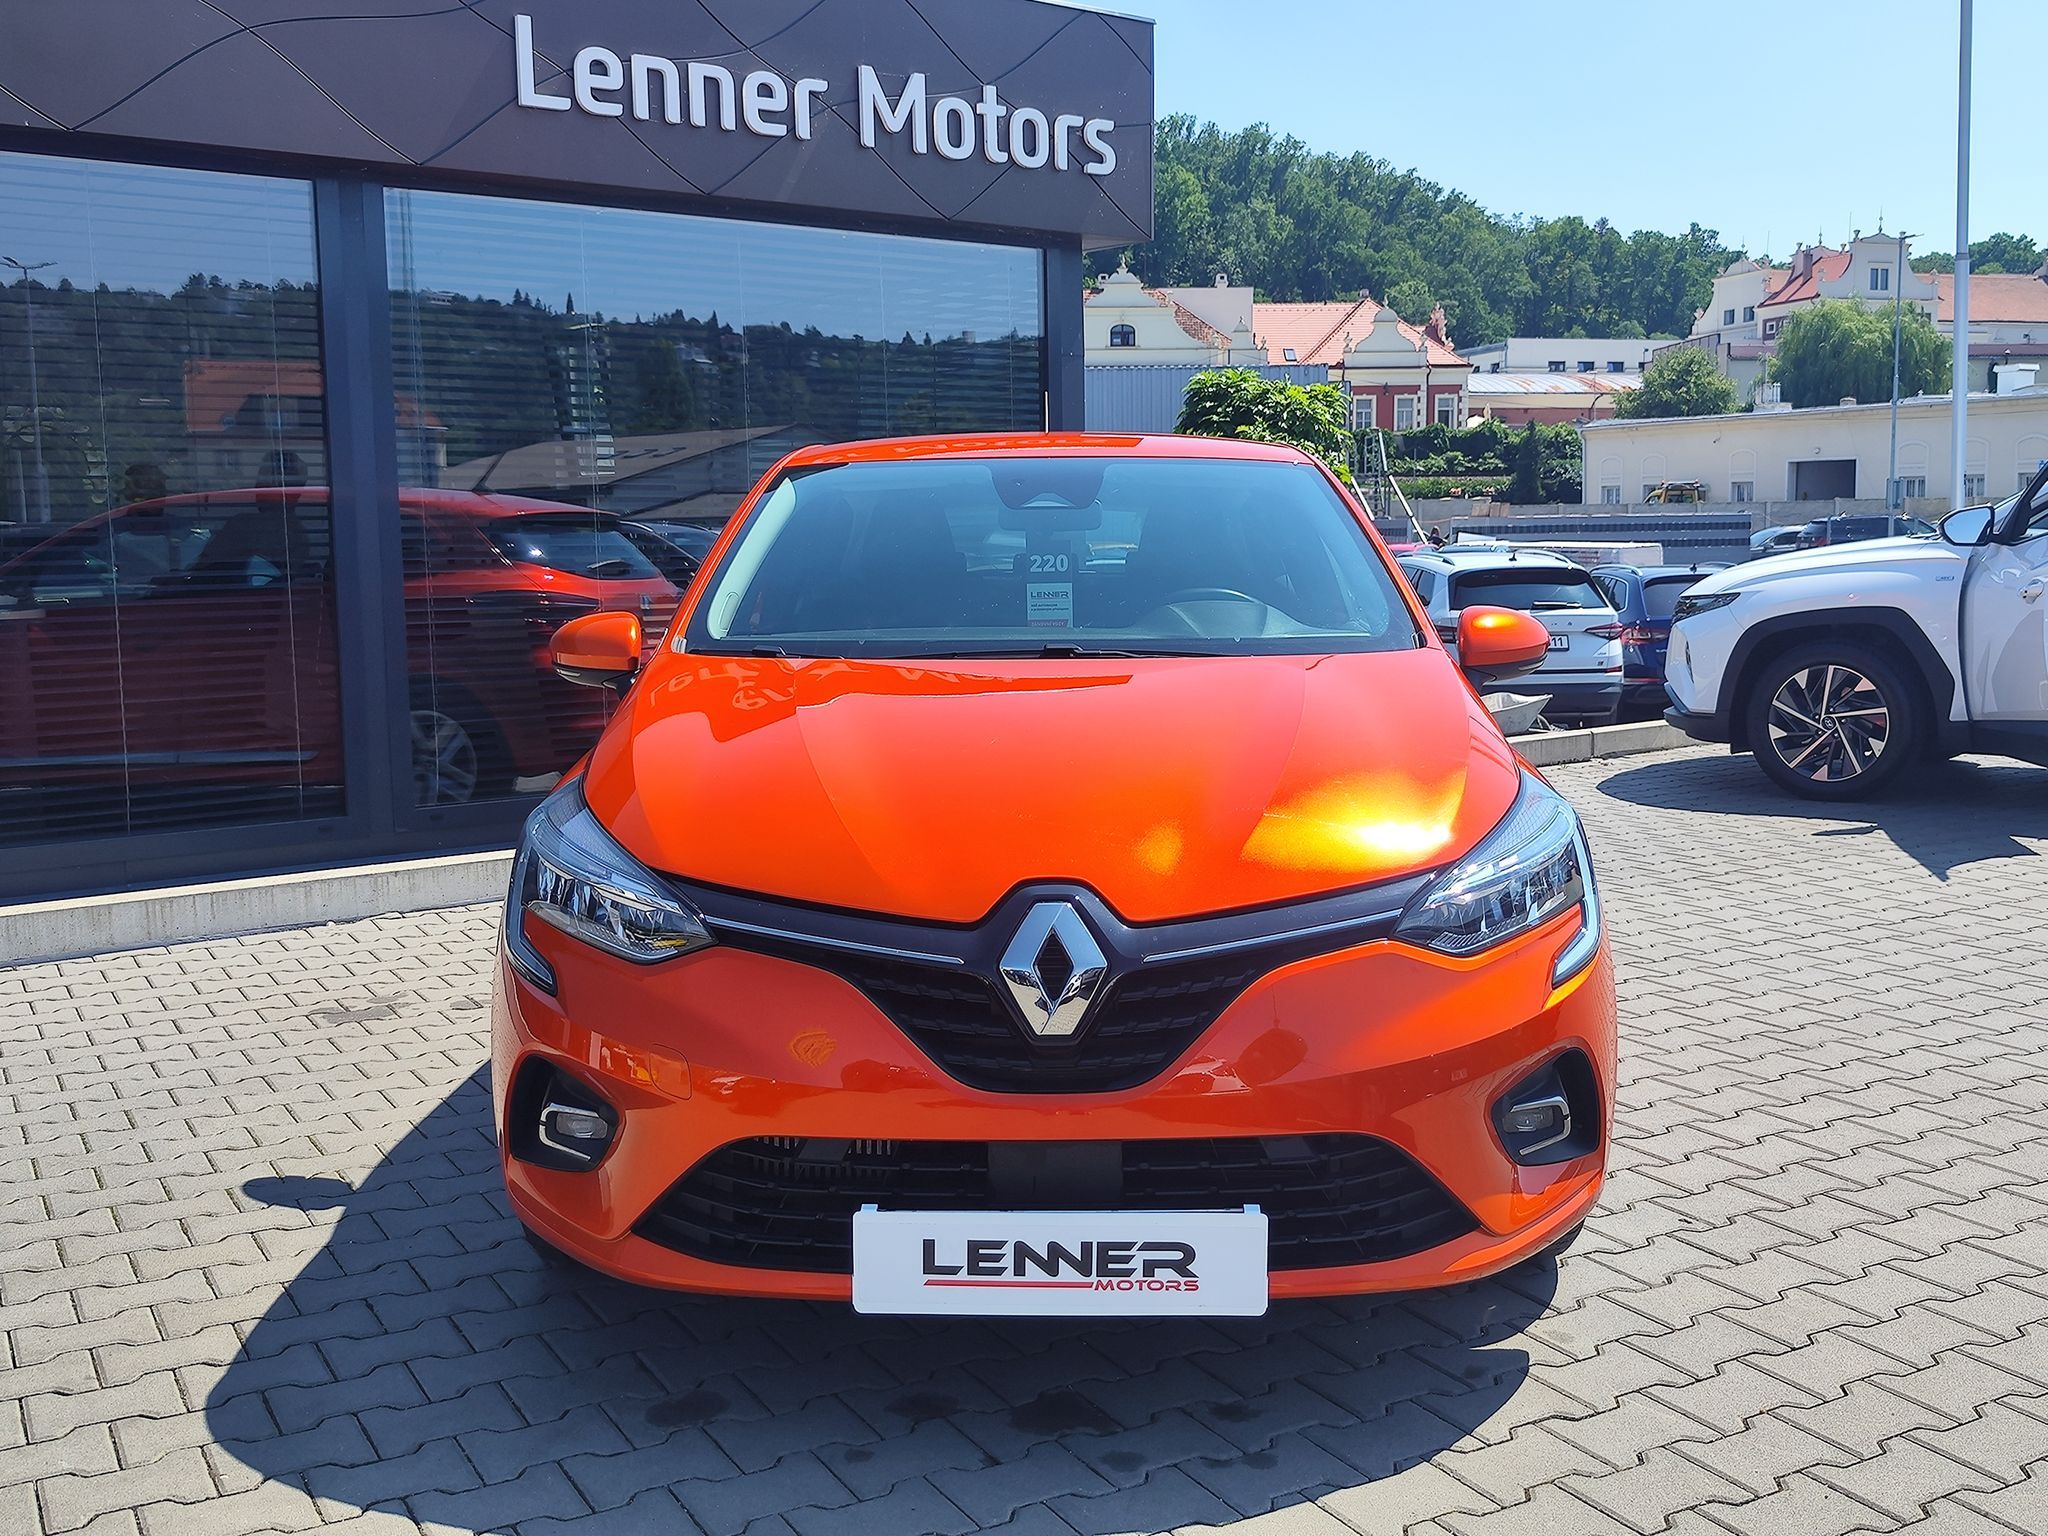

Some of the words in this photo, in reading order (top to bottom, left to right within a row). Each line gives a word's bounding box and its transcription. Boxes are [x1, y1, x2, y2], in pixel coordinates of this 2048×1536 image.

[514, 13, 829, 142] Lenner
[858, 64, 1117, 177] Motors
[1030, 554, 1069, 572] 220
[922, 1238, 1200, 1279] LENNER
[1093, 1279, 1200, 1292] MOTORS
